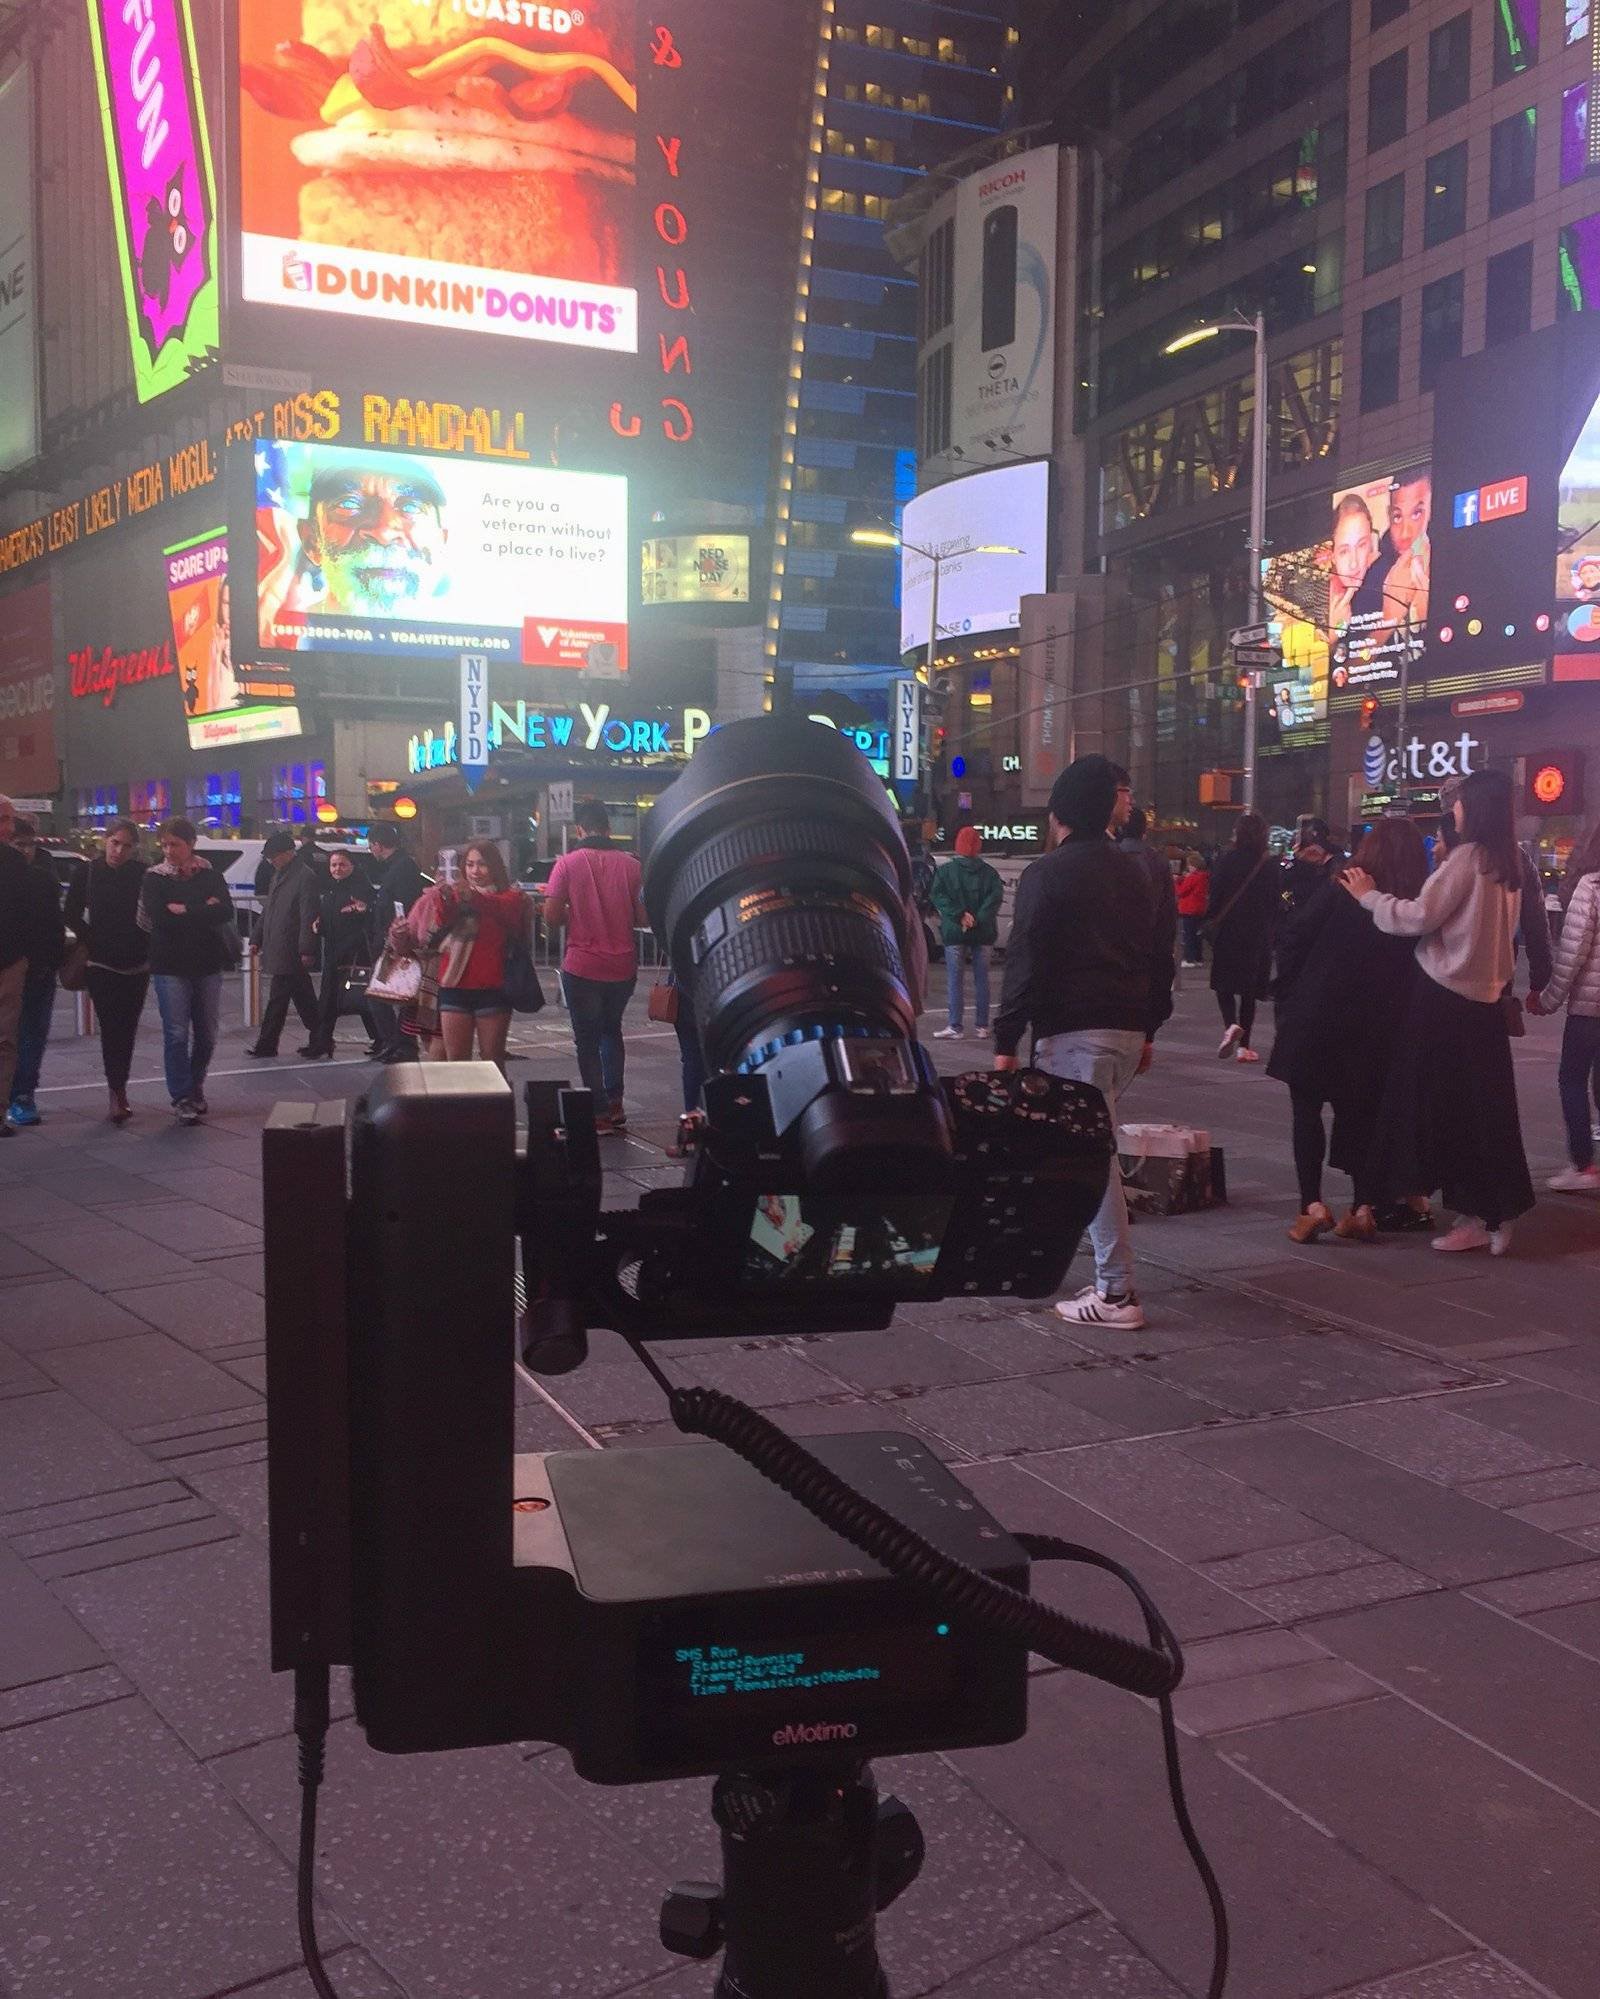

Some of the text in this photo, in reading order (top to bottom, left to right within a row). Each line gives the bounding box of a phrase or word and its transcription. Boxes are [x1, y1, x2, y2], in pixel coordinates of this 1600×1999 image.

[978, 169, 1026, 198] RICOH
[978, 377, 1020, 399] THETA
[47, 501, 80, 551] LEAST
[84, 480, 122, 535] LIKELY
[127, 461, 164, 516] MEDIA
[169, 438, 218, 498] MOGUL:
[361, 393, 531, 460] RANDALL
[482, 492, 560, 513] Are you a
[1485, 486, 1520, 511] LIVE
[482, 518, 612, 540] veteran without
[482, 541, 606, 562] a place to live?
[699, 547, 725, 560] RED
[169, 551, 204, 584] SCARE
[204, 545, 221, 572] UP
[699, 571, 723, 583] DAY
[467, 658, 482, 761] NYPD
[902, 683, 915, 776] NYPD
[1386, 731, 1480, 780] at&t
[709, 1646, 738, 1660] Run
[689, 1683, 727, 1696] Time
[772, 1722, 859, 1746] eMotimo
